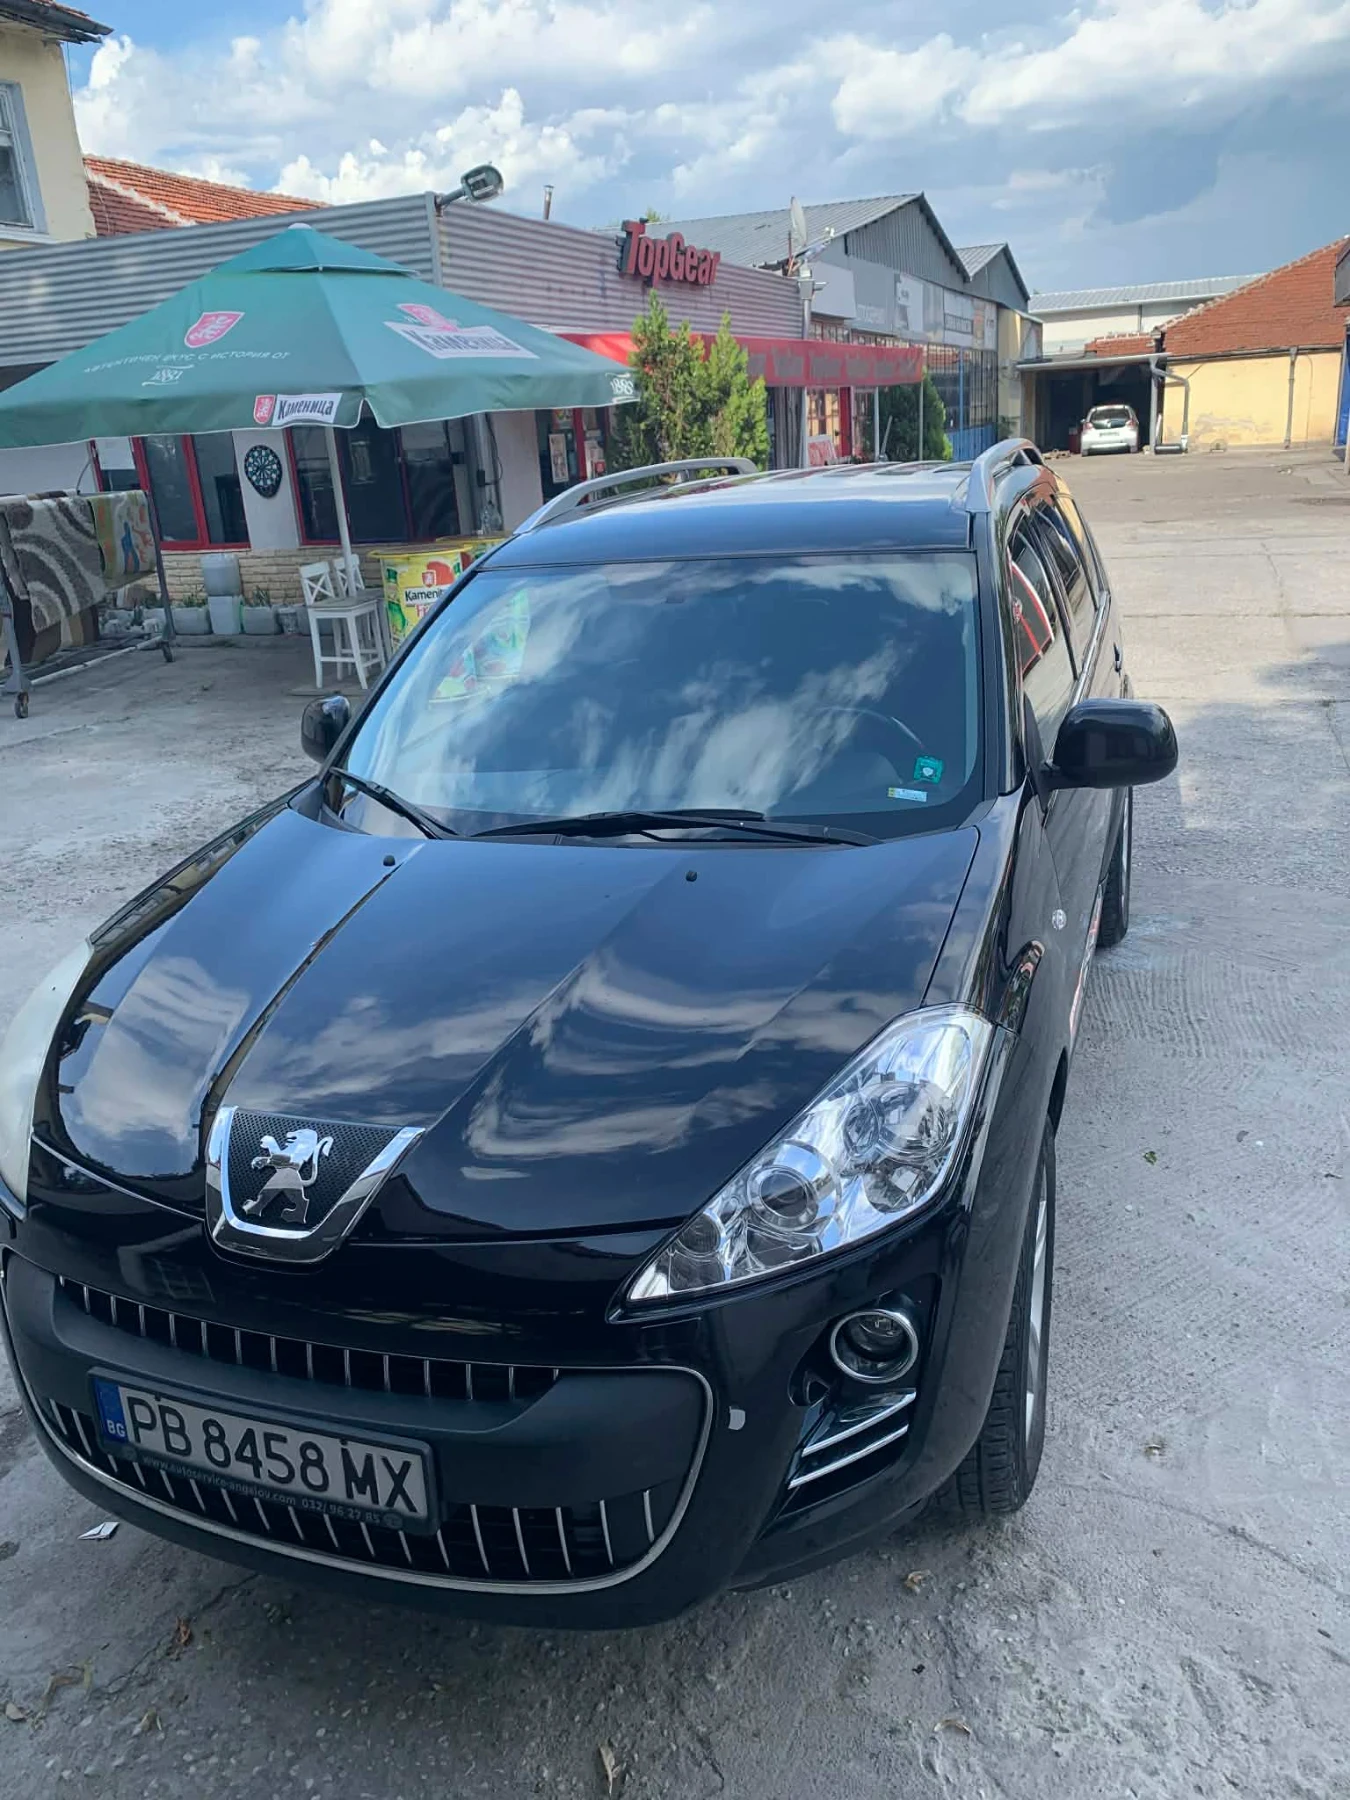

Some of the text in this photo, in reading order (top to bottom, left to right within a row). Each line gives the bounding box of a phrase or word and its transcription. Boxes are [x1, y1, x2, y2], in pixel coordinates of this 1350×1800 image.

[620, 218, 720, 288] TopGear
[277, 400, 335, 420] Каменица
[106, 1419, 126, 1438] BG
[126, 1396, 418, 1513] PB 8458 MX
